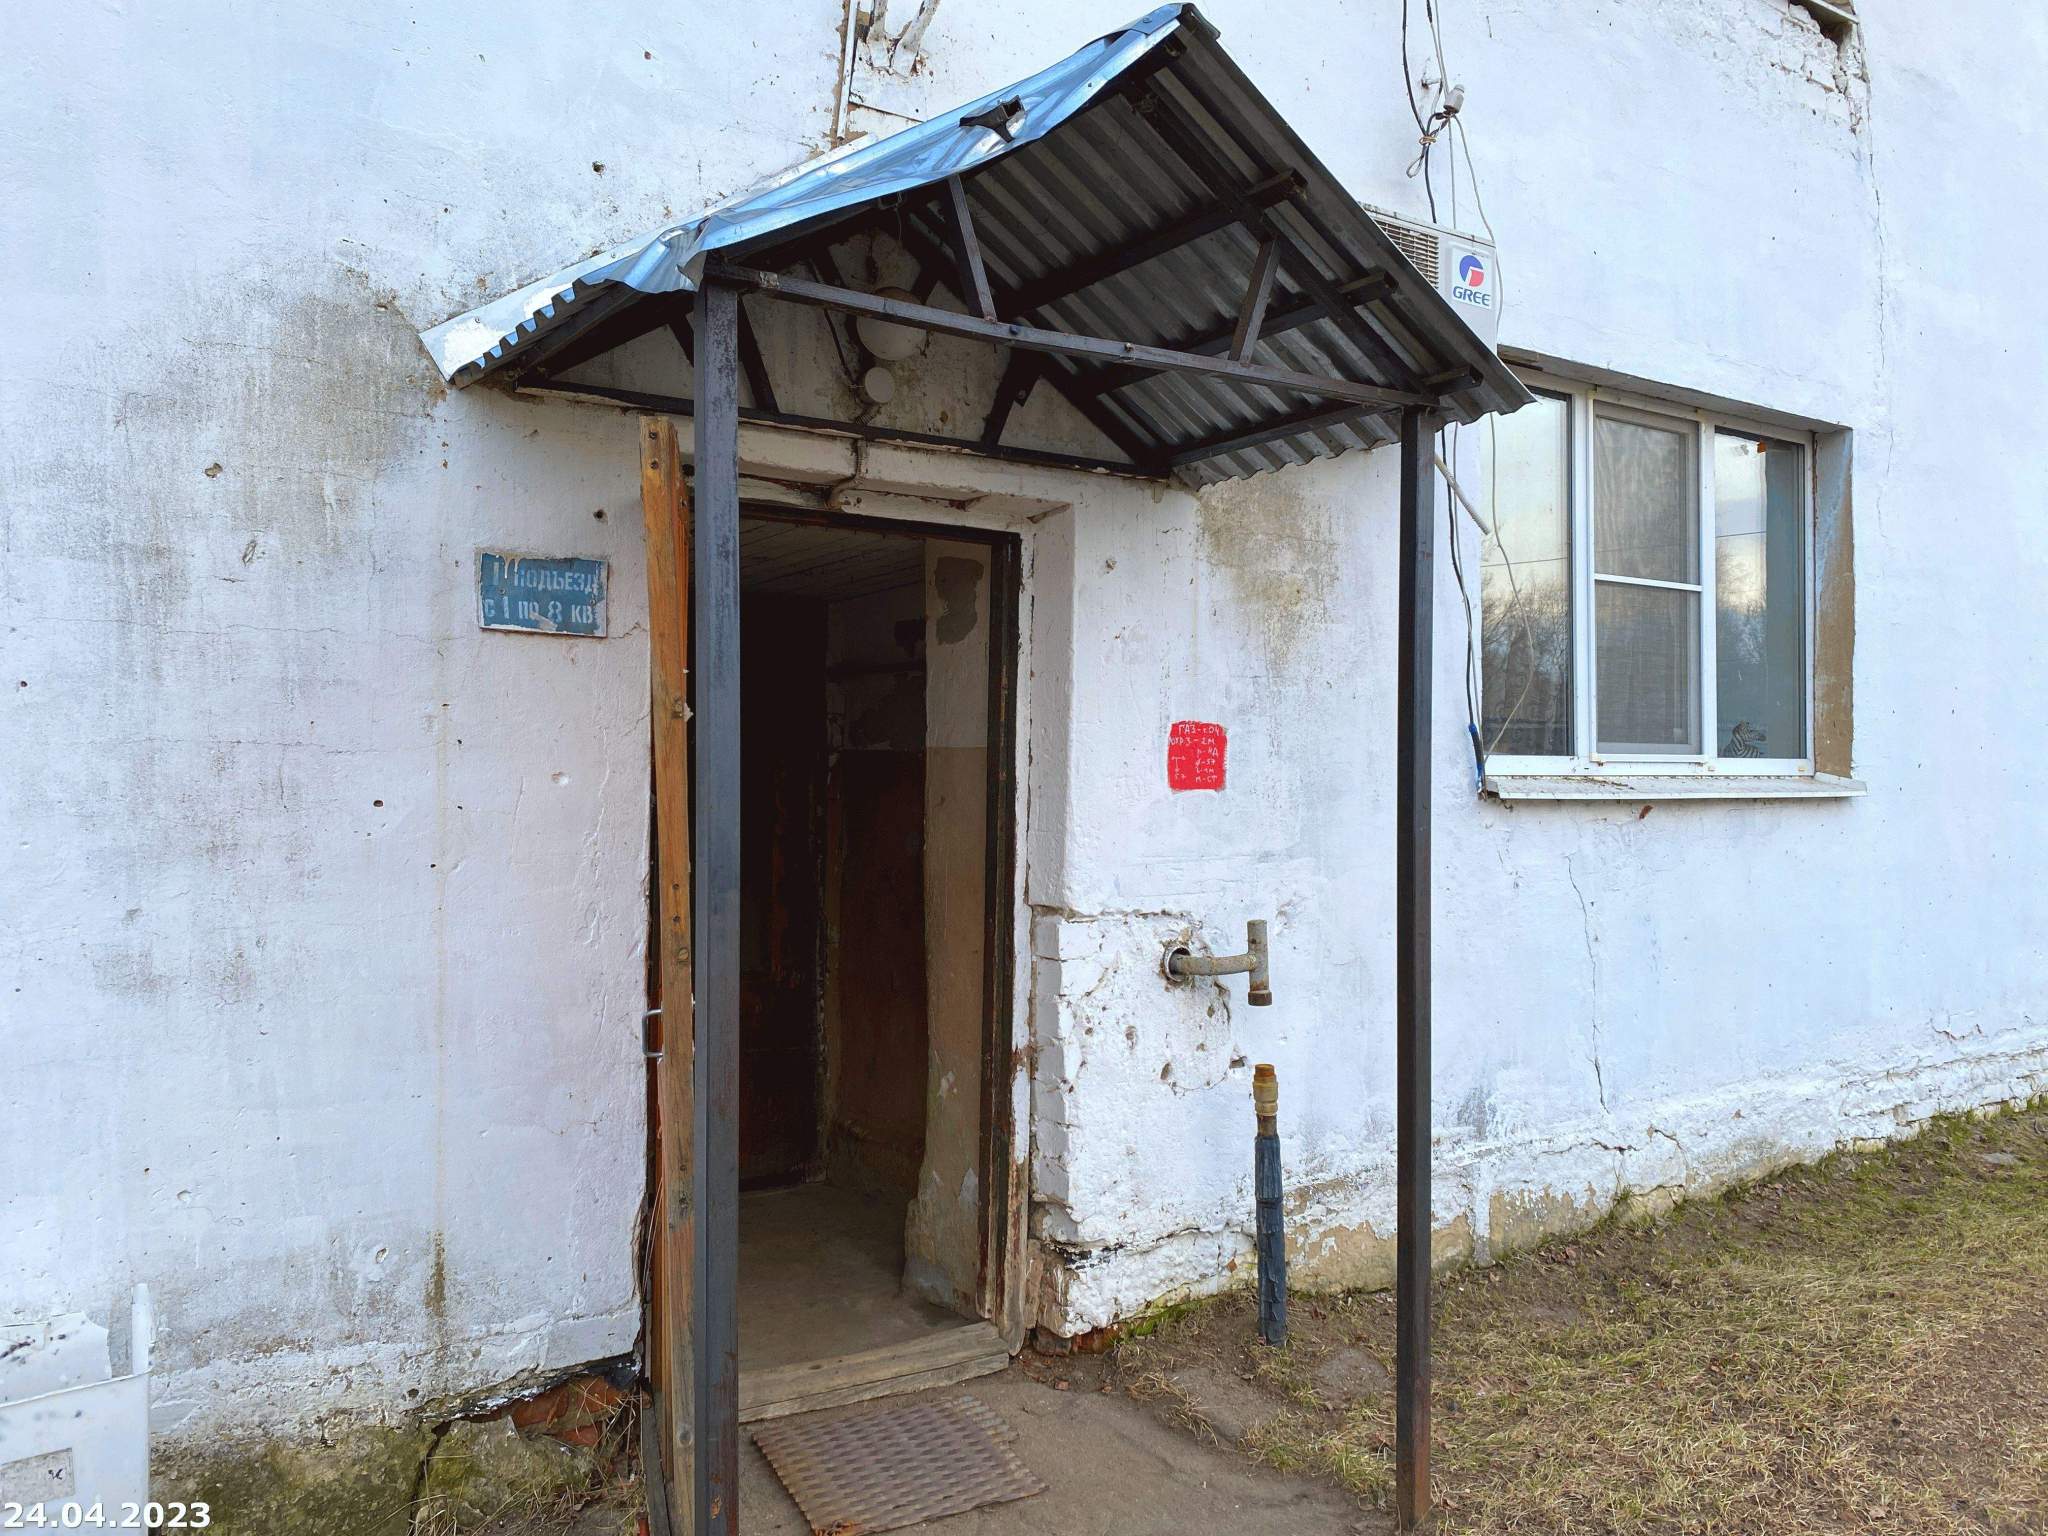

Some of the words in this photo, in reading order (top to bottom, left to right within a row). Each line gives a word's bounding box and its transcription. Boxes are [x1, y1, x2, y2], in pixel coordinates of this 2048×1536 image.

[1453, 285, 1491, 307] GREE
[514, 566, 598, 597] ПОДЪЕЗД
[502, 596, 510, 619] 1
[547, 600, 563, 623] 8
